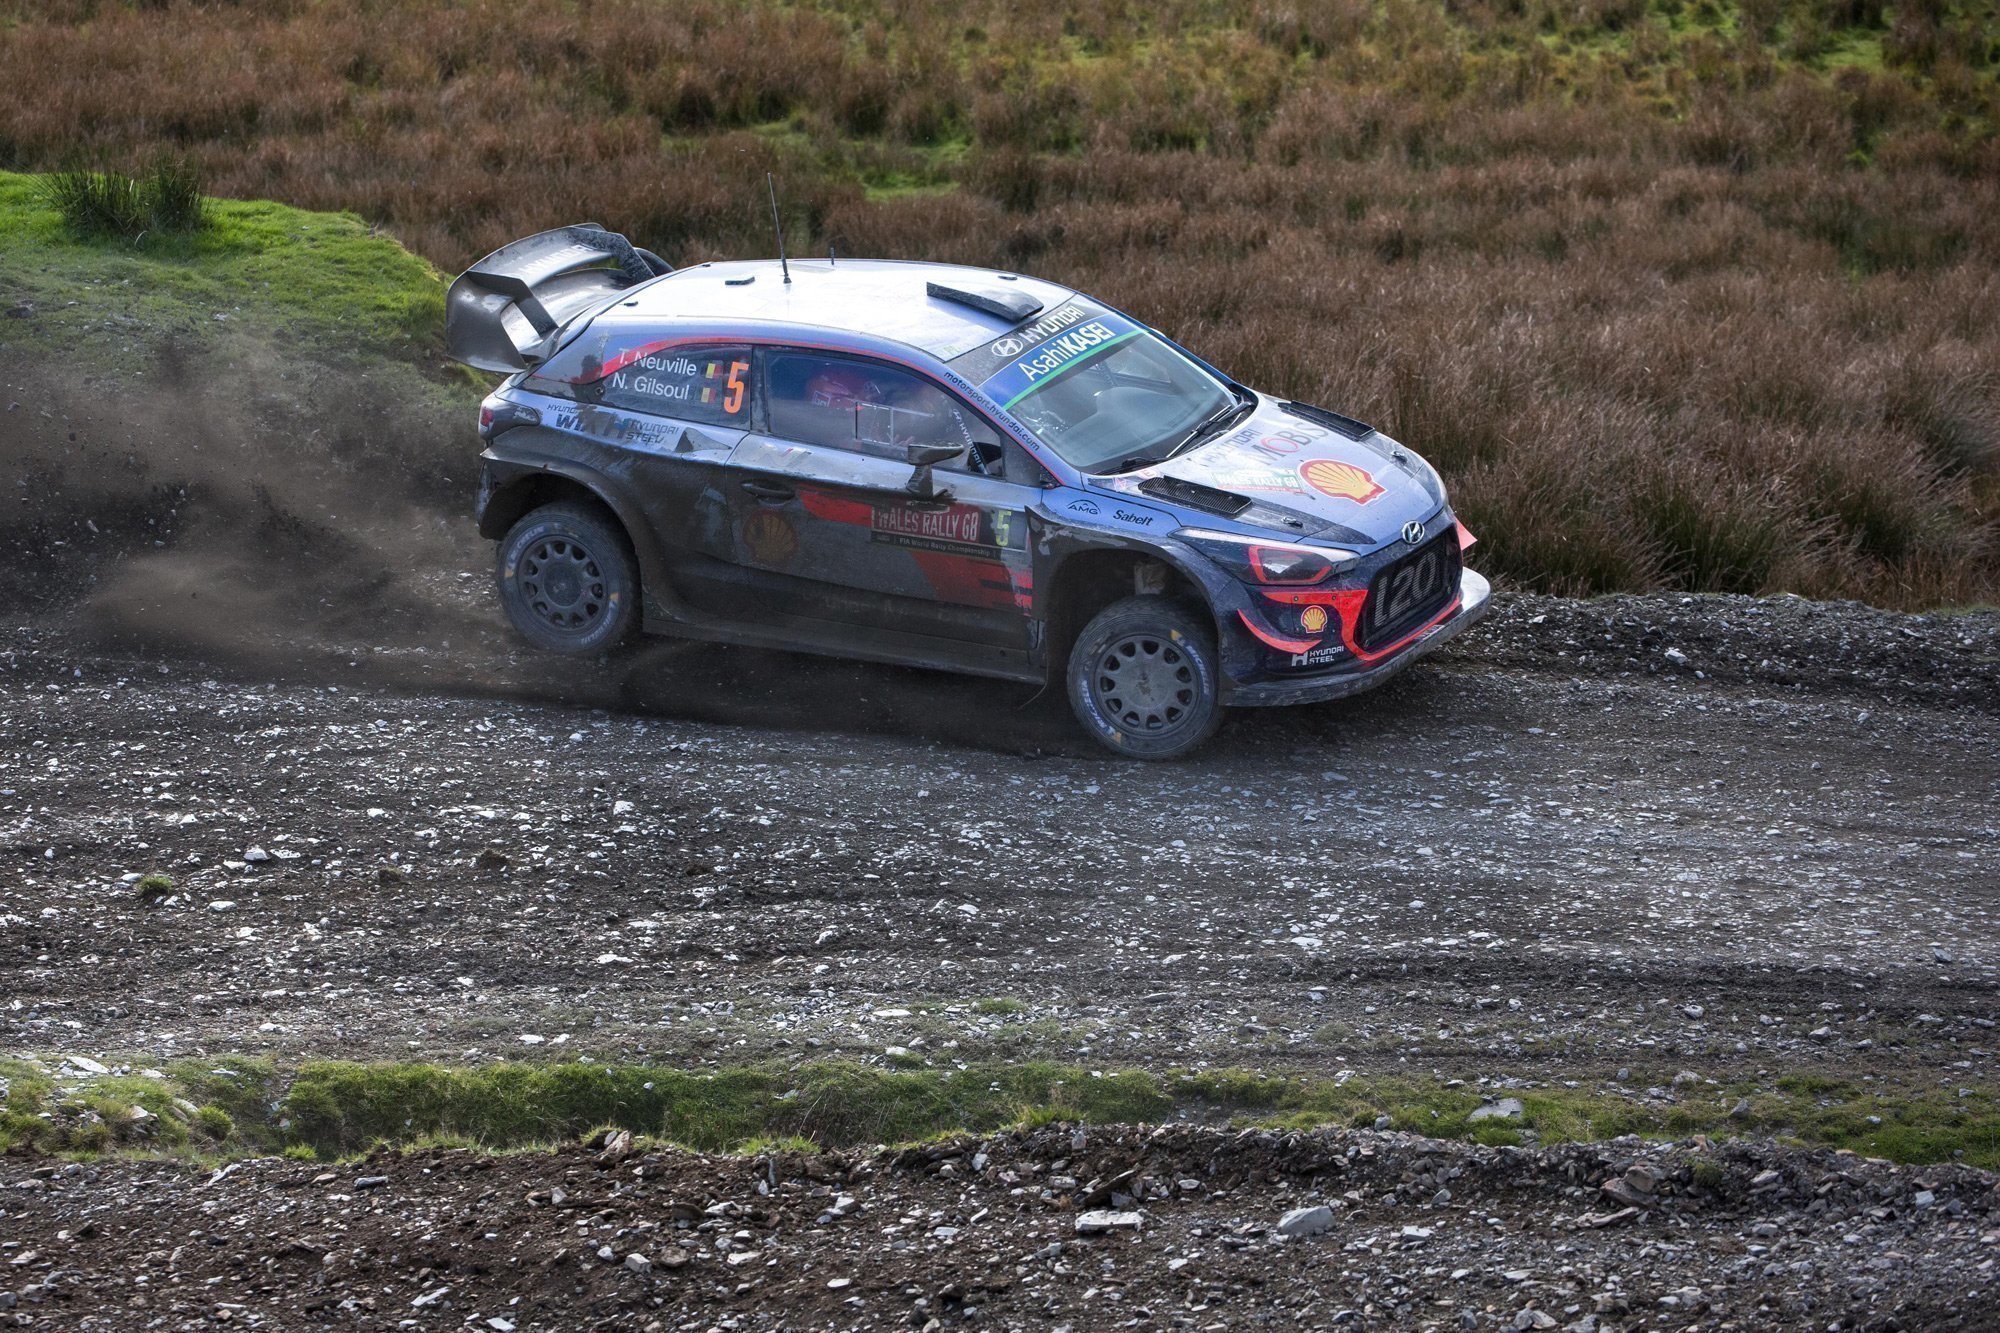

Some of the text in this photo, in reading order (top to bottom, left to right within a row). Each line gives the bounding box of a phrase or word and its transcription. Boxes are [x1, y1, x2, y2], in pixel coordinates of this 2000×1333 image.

[1018, 305, 1086, 344] HYUNDAI
[618, 347, 697, 377] T. Neuville
[1018, 321, 1117, 382] AsahiKASEI
[612, 372, 690, 401] N. Gilsoul
[723, 361, 750, 414] 5
[547, 404, 582, 415] HYUND
[943, 371, 1040, 451] motorsport.hyundai.com
[1249, 421, 1329, 466] MOBIS
[878, 507, 978, 541] WALES RALLY GB
[995, 510, 1012, 547] 5
[1113, 509, 1154, 526] Sabelt
[1309, 645, 1344, 657] HYUNDAI
[1309, 654, 1335, 664] STEEL
